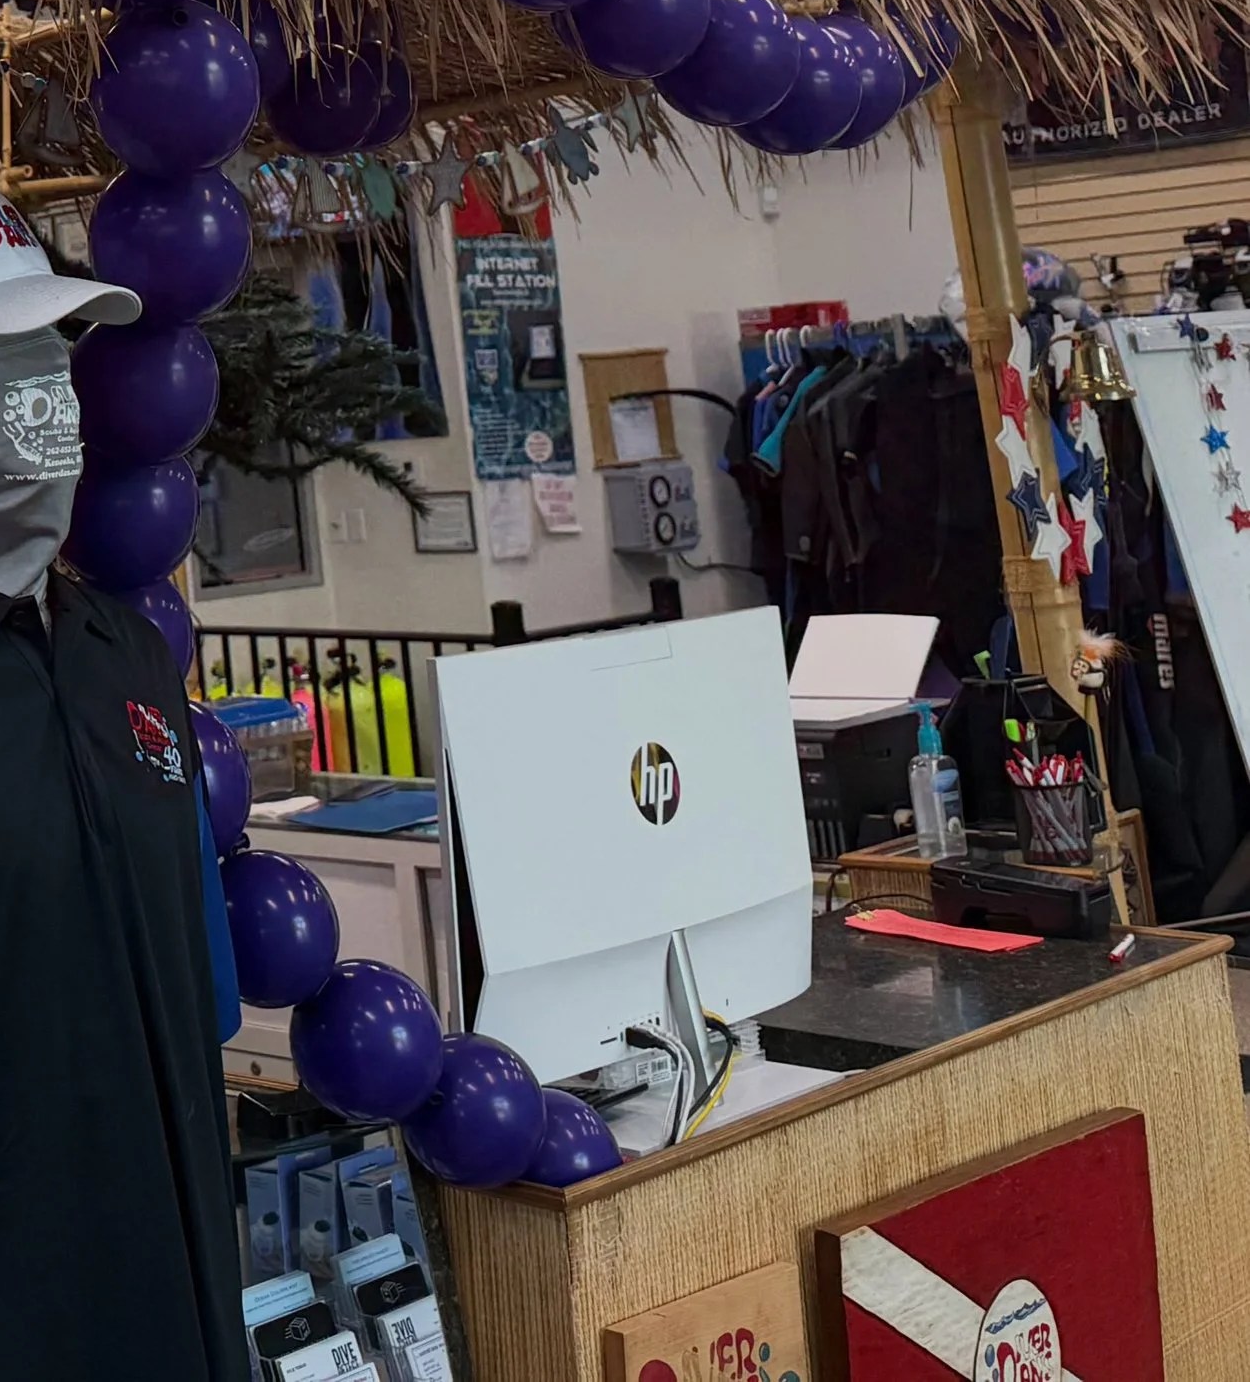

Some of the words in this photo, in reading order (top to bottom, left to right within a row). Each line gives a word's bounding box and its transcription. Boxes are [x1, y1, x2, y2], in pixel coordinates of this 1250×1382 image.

[1136, 101, 1222, 131] DEALER
[464, 274, 494, 289] FILL
[496, 273, 556, 289] STATION
[1152, 612, 1175, 690] mares
[638, 741, 675, 826] hp
[331, 1342, 357, 1369] DIVE
